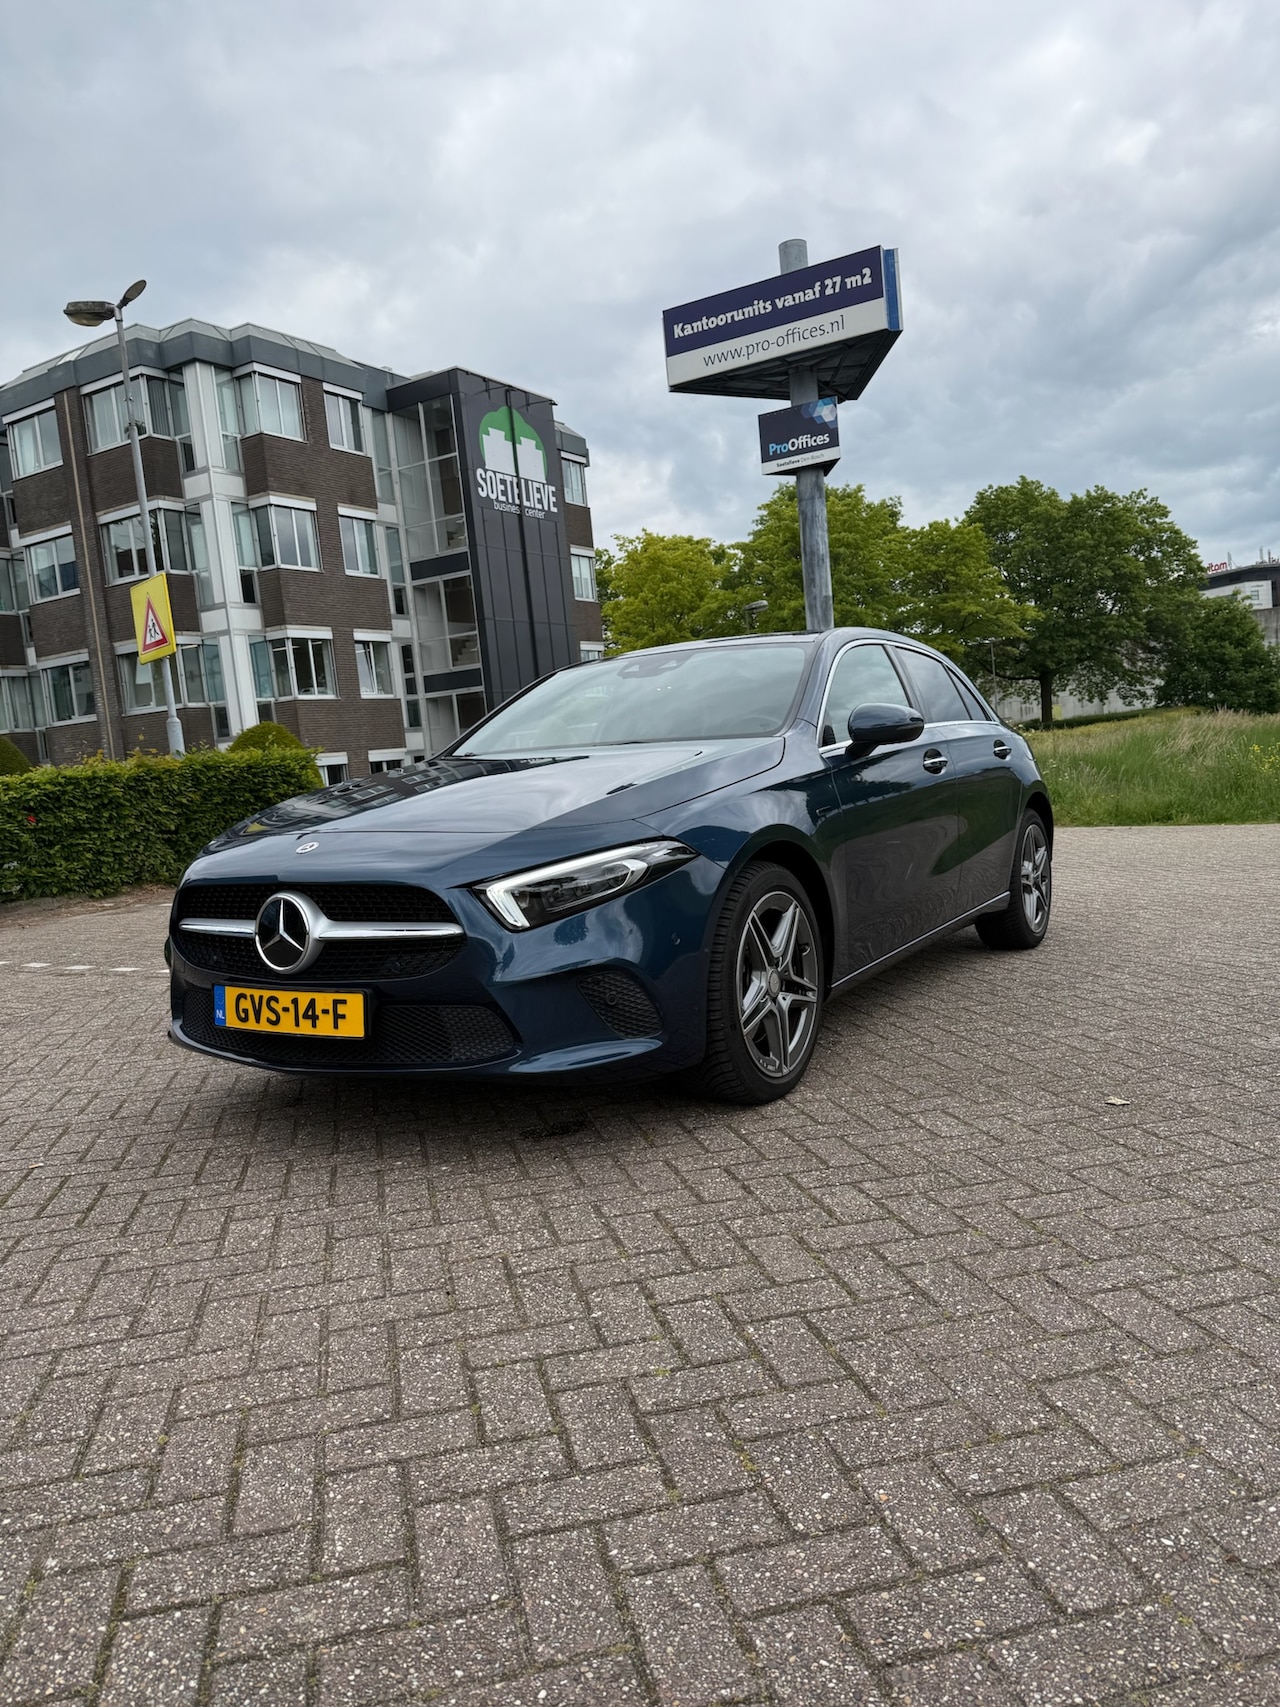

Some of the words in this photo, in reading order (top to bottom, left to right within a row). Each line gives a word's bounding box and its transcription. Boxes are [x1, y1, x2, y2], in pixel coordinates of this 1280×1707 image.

[672, 299, 773, 339] Kantoorunits
[774, 281, 822, 308] vanaf
[824, 275, 842, 296] 27
[845, 267, 873, 290] m2
[703, 314, 846, 367] www.pro-offices.nl
[768, 433, 830, 456] ProOffices
[493, 499, 521, 515] busines
[524, 508, 546, 519] center
[216, 1009, 226, 1020] NL
[234, 992, 348, 1030] GVS-14-F
